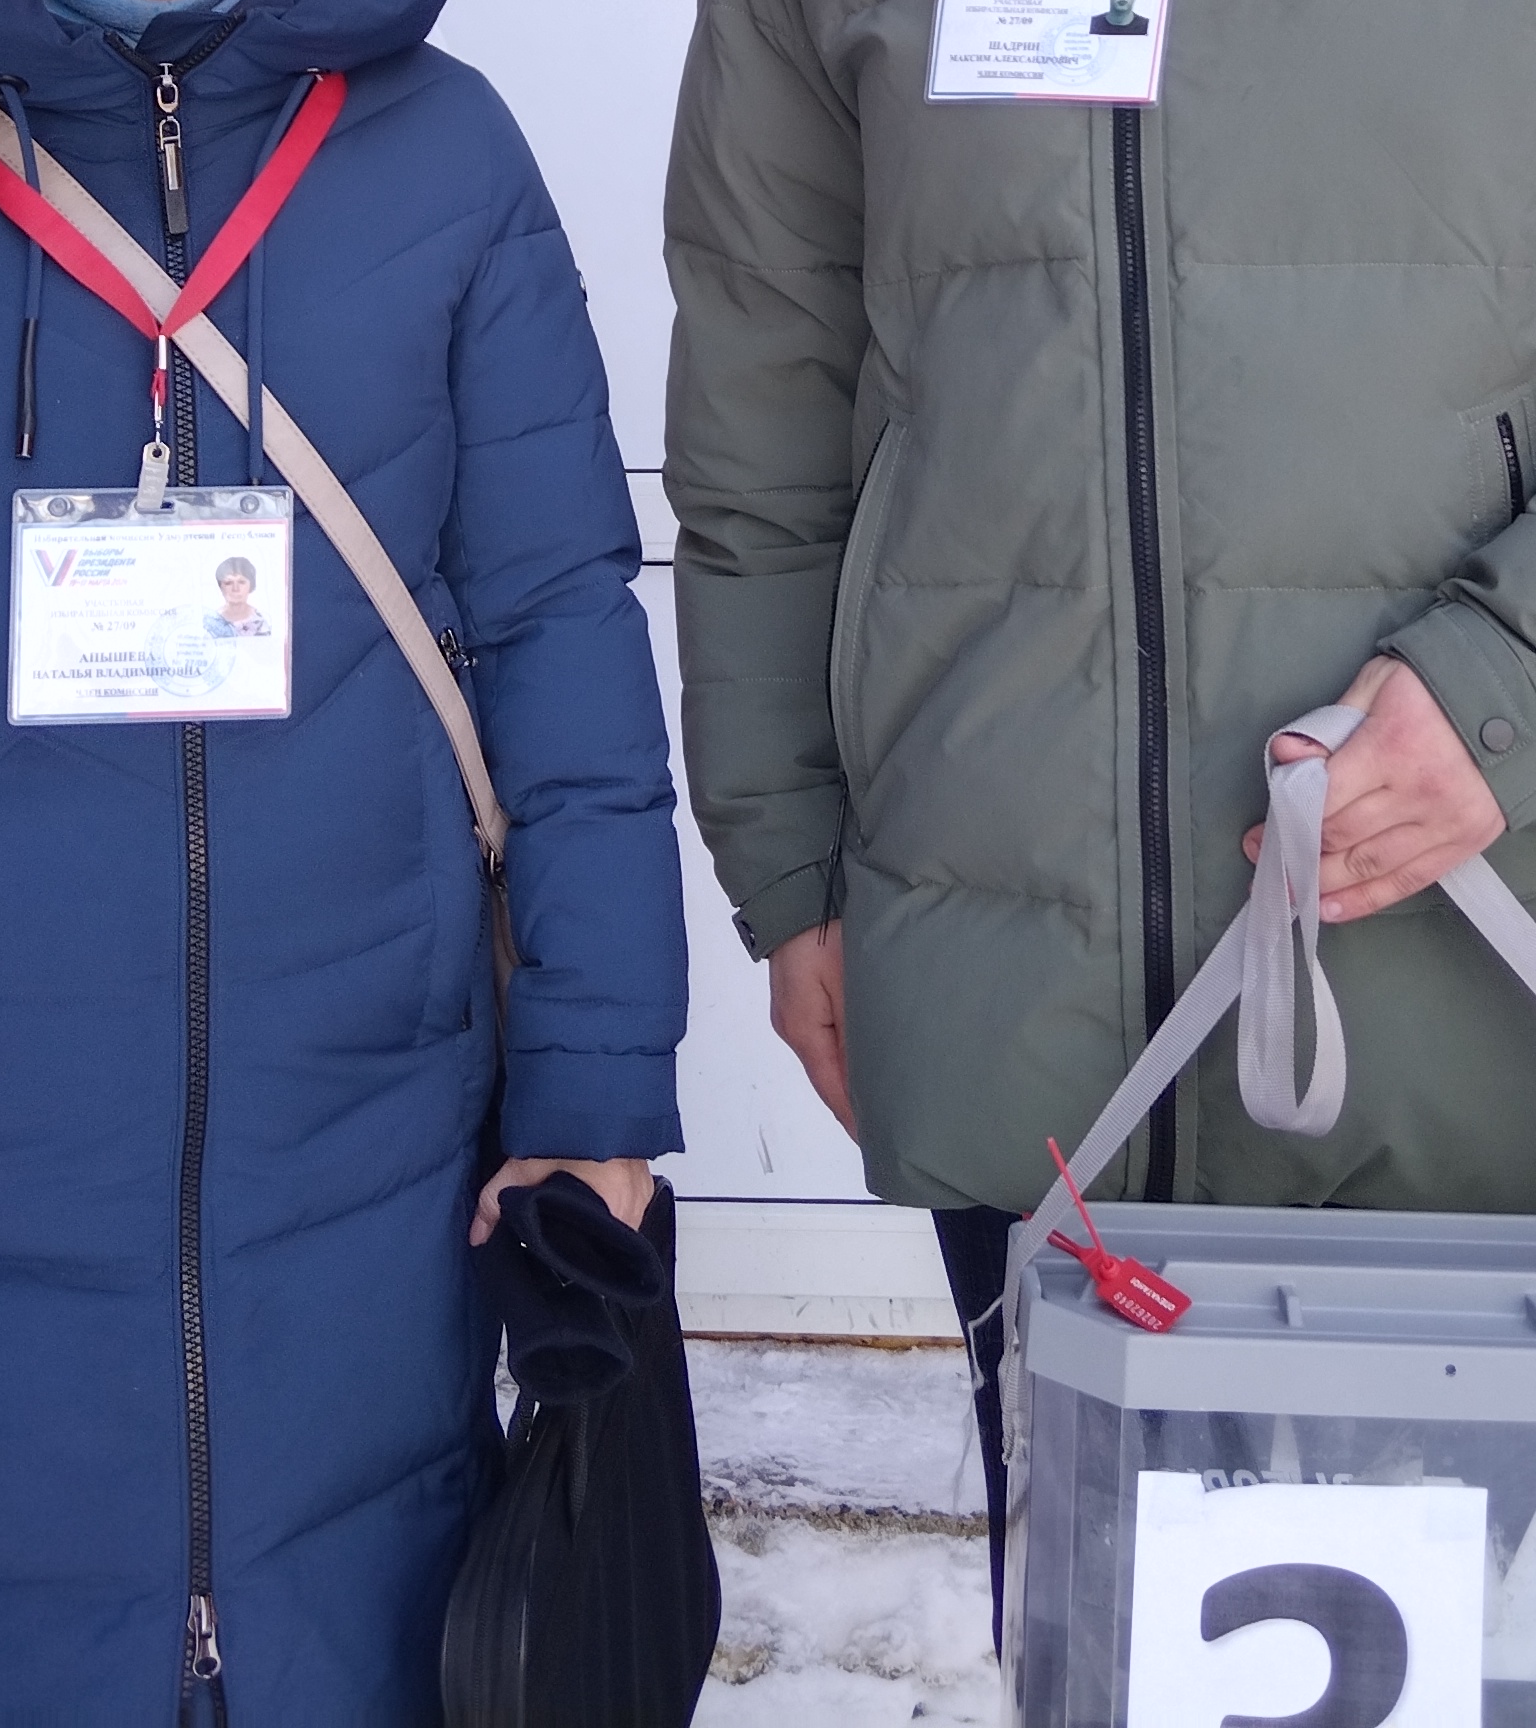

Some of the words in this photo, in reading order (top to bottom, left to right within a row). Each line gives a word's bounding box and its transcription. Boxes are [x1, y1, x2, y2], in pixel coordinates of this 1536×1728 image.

[989, 41, 1040, 52] ШАДРИН
[949, 54, 992, 64] МАКСИМ
[77, 558, 136, 568] ПРЕЗИДЕНТА
[73, 568, 111, 578] РОССИИ
[92, 621, 104, 632] №
[106, 620, 136, 631] 27/09
[32, 668, 93, 680] НАТАЛЬЯ
[95, 665, 203, 678] ВЛАДИМИРОВНА
